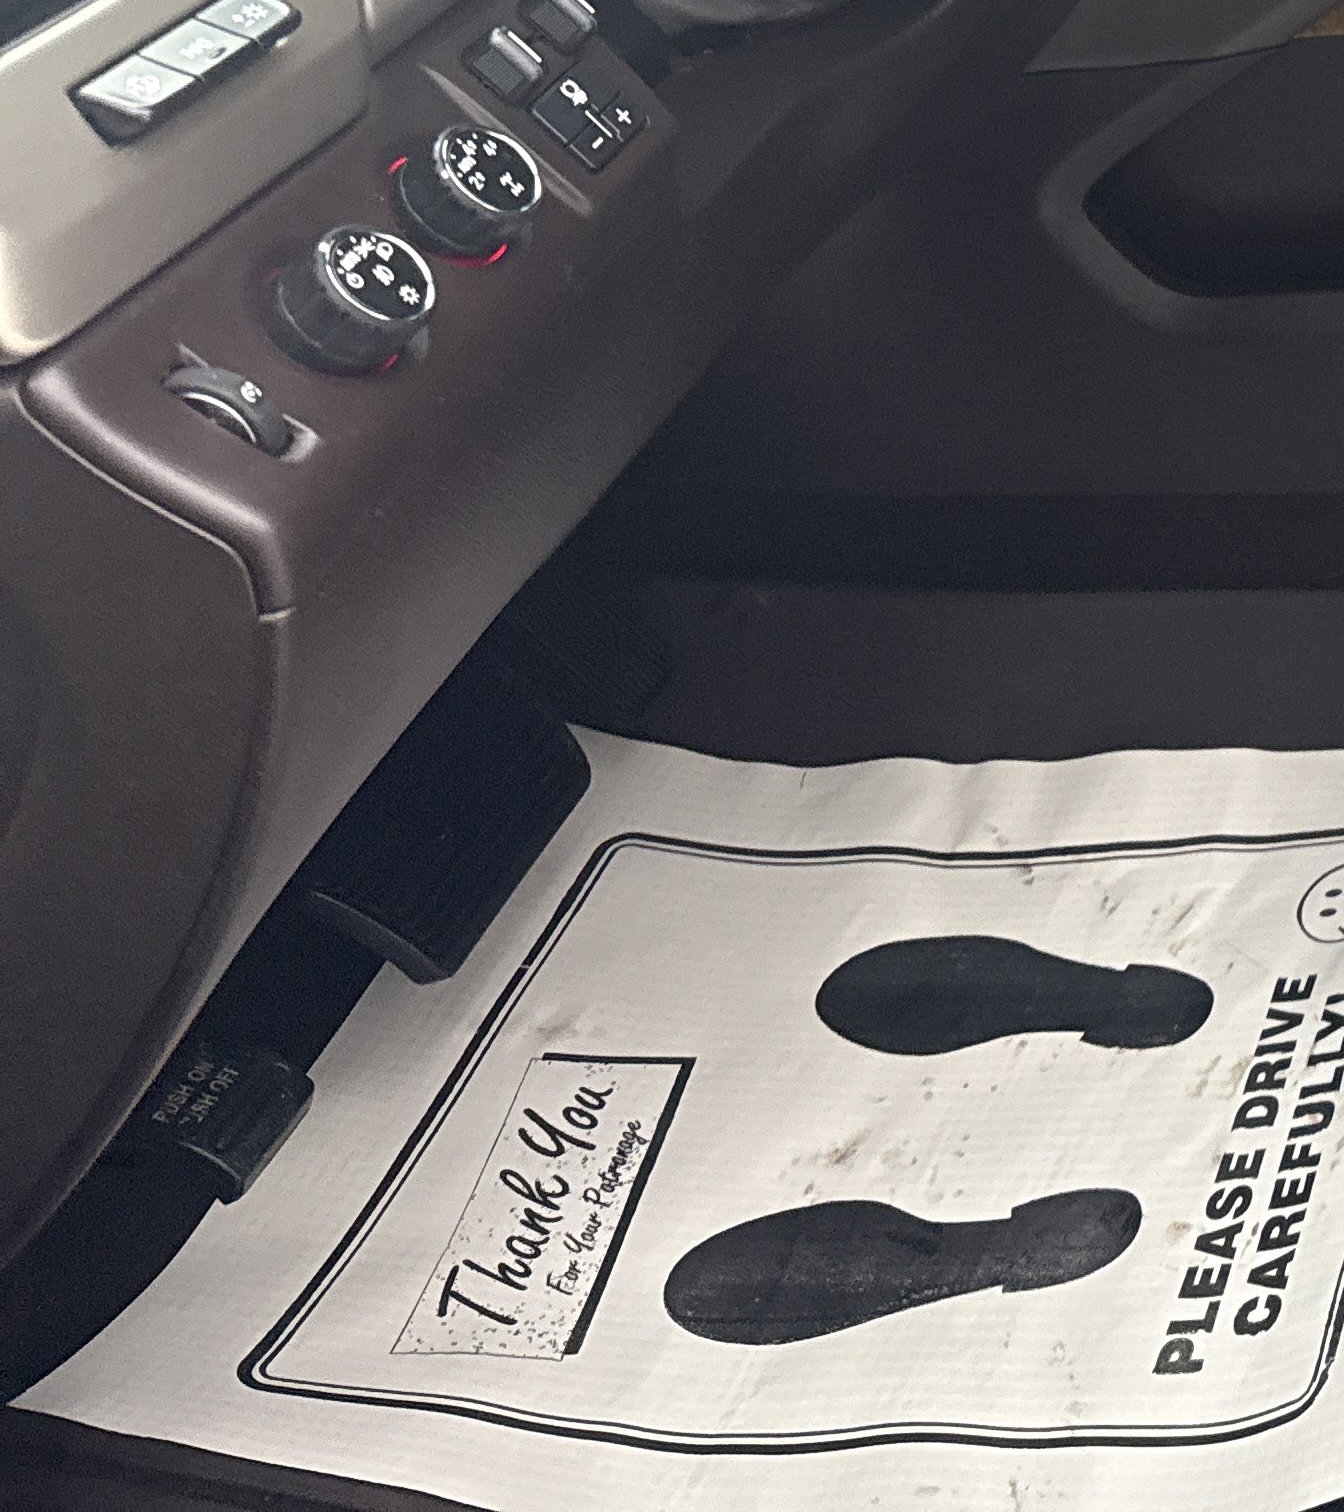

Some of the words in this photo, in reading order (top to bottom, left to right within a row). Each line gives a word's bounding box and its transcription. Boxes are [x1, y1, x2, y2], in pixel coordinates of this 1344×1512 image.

[152, 1083, 196, 1124] PUSH
[583, 1119, 650, 1208] Patronage
[1152, 1148, 1267, 1376] PLEASE
[1231, 973, 1318, 1133] DRIVE
[436, 1168, 570, 1326] Thank
[518, 1086, 614, 1158] You
[563, 1212, 602, 1253] Your
[546, 1259, 582, 1296] For
